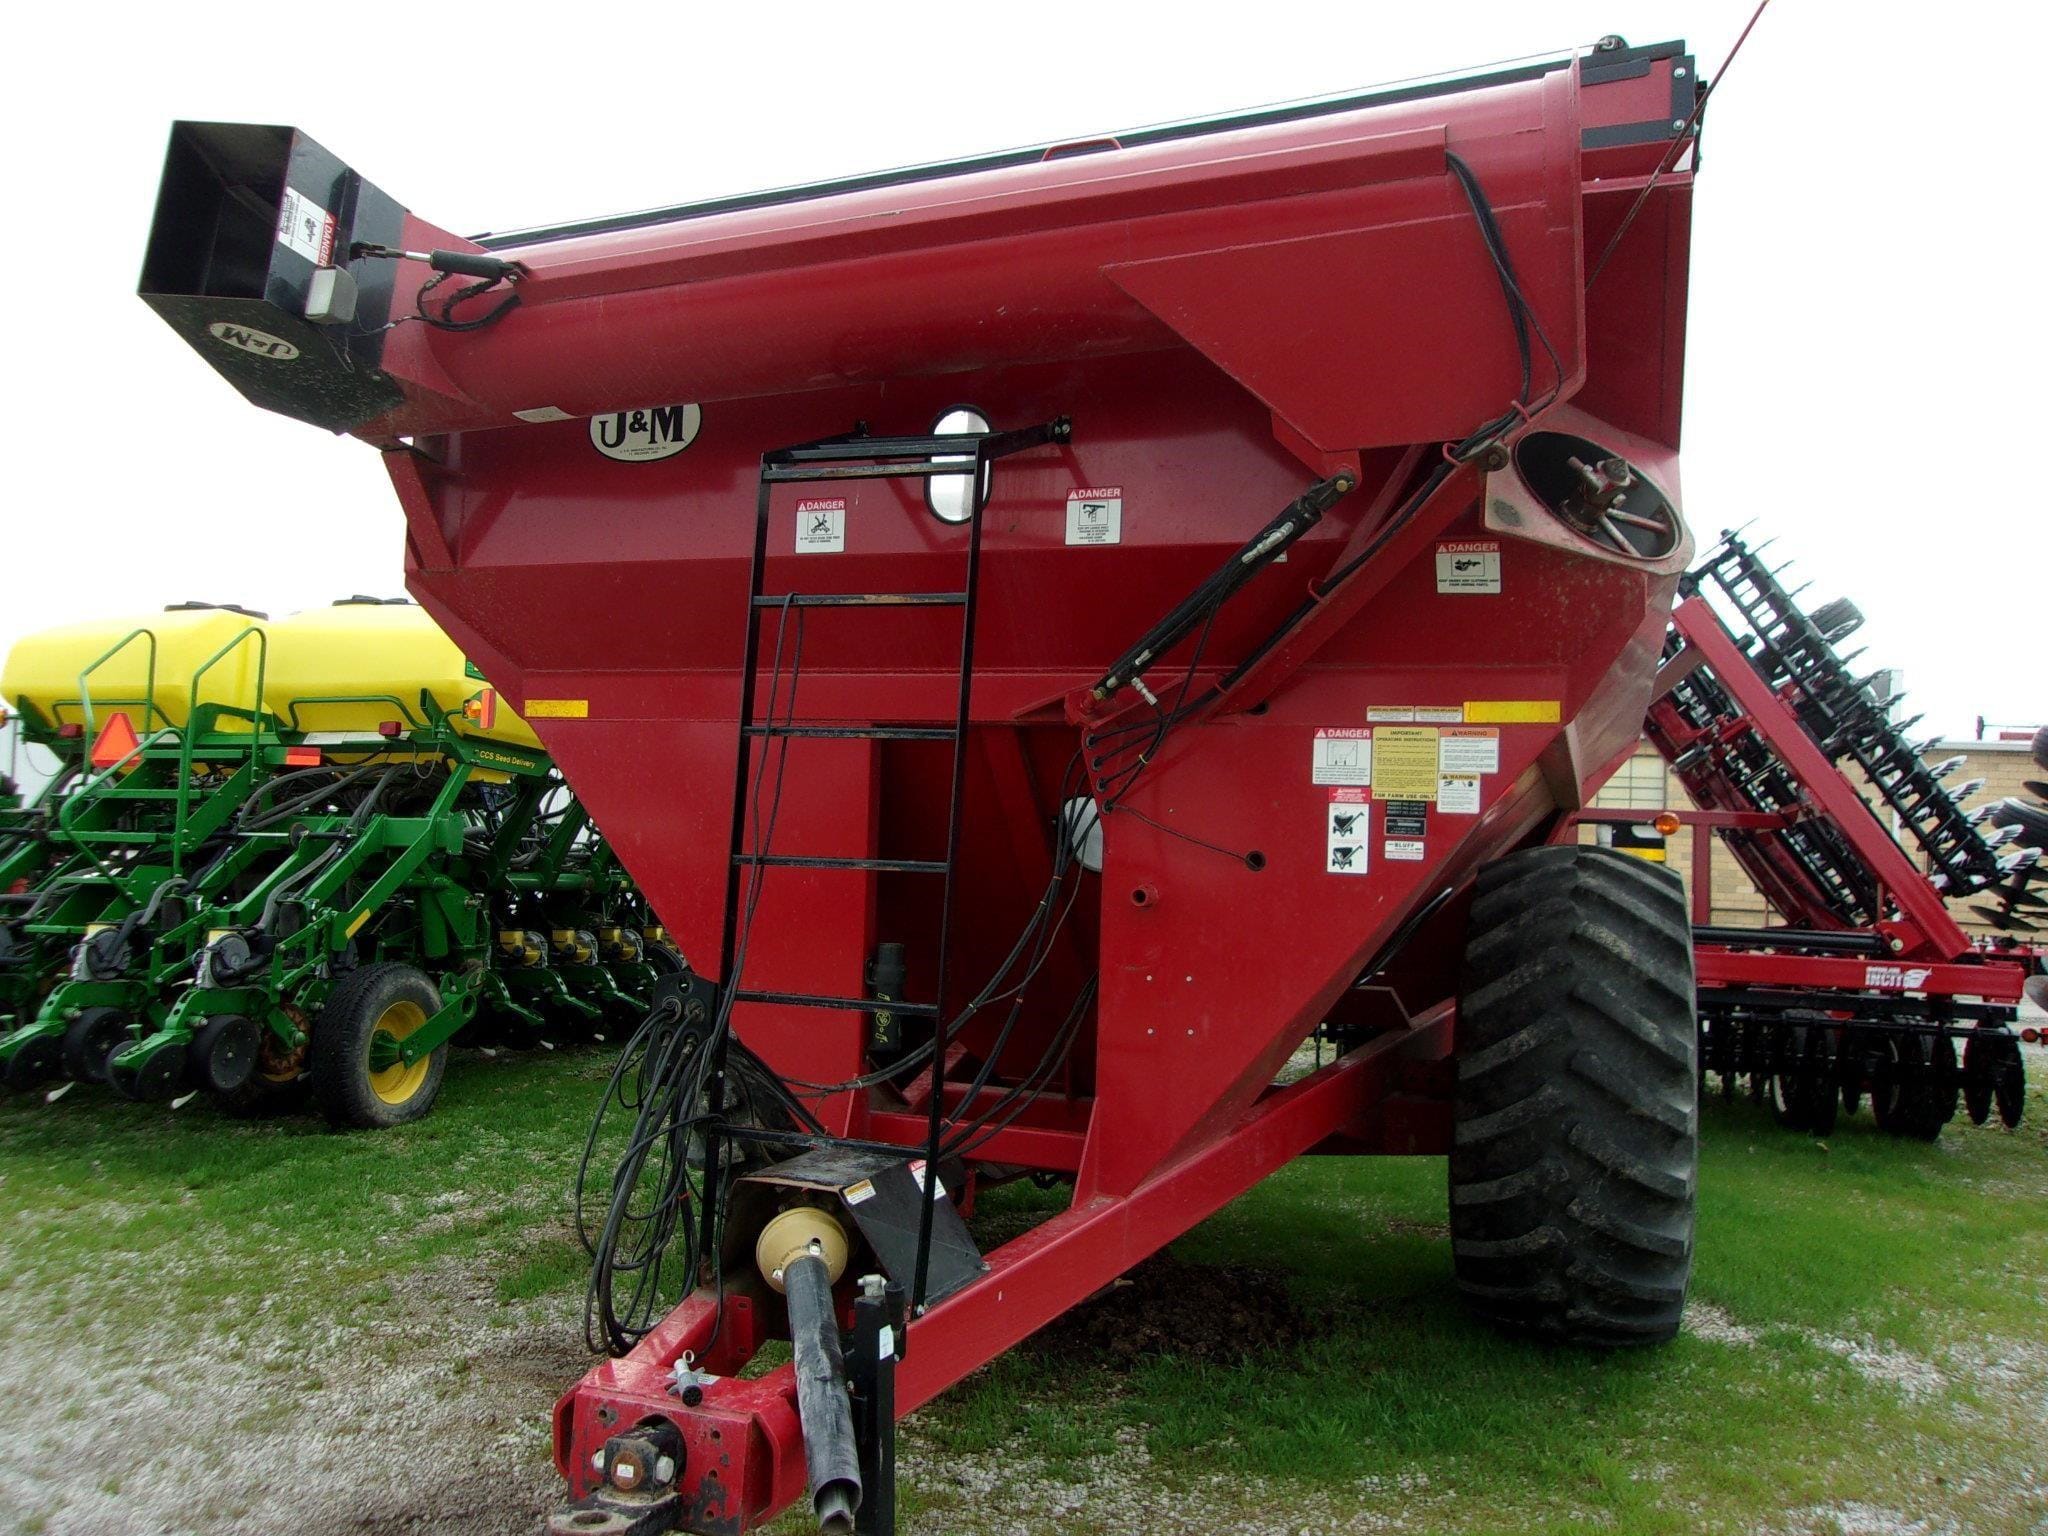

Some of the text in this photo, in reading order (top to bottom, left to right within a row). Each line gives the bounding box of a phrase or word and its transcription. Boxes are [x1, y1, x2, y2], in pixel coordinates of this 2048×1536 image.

[319, 223, 336, 267] DANGER
[221, 325, 292, 355] J&M
[598, 404, 685, 449] J&M
[1078, 488, 1121, 499] DANGER
[806, 500, 844, 510] DANGER
[1448, 543, 1498, 552] DANGER
[1327, 729, 1370, 738] DANGER
[480, 751, 536, 769] CCS Seed Delivery
